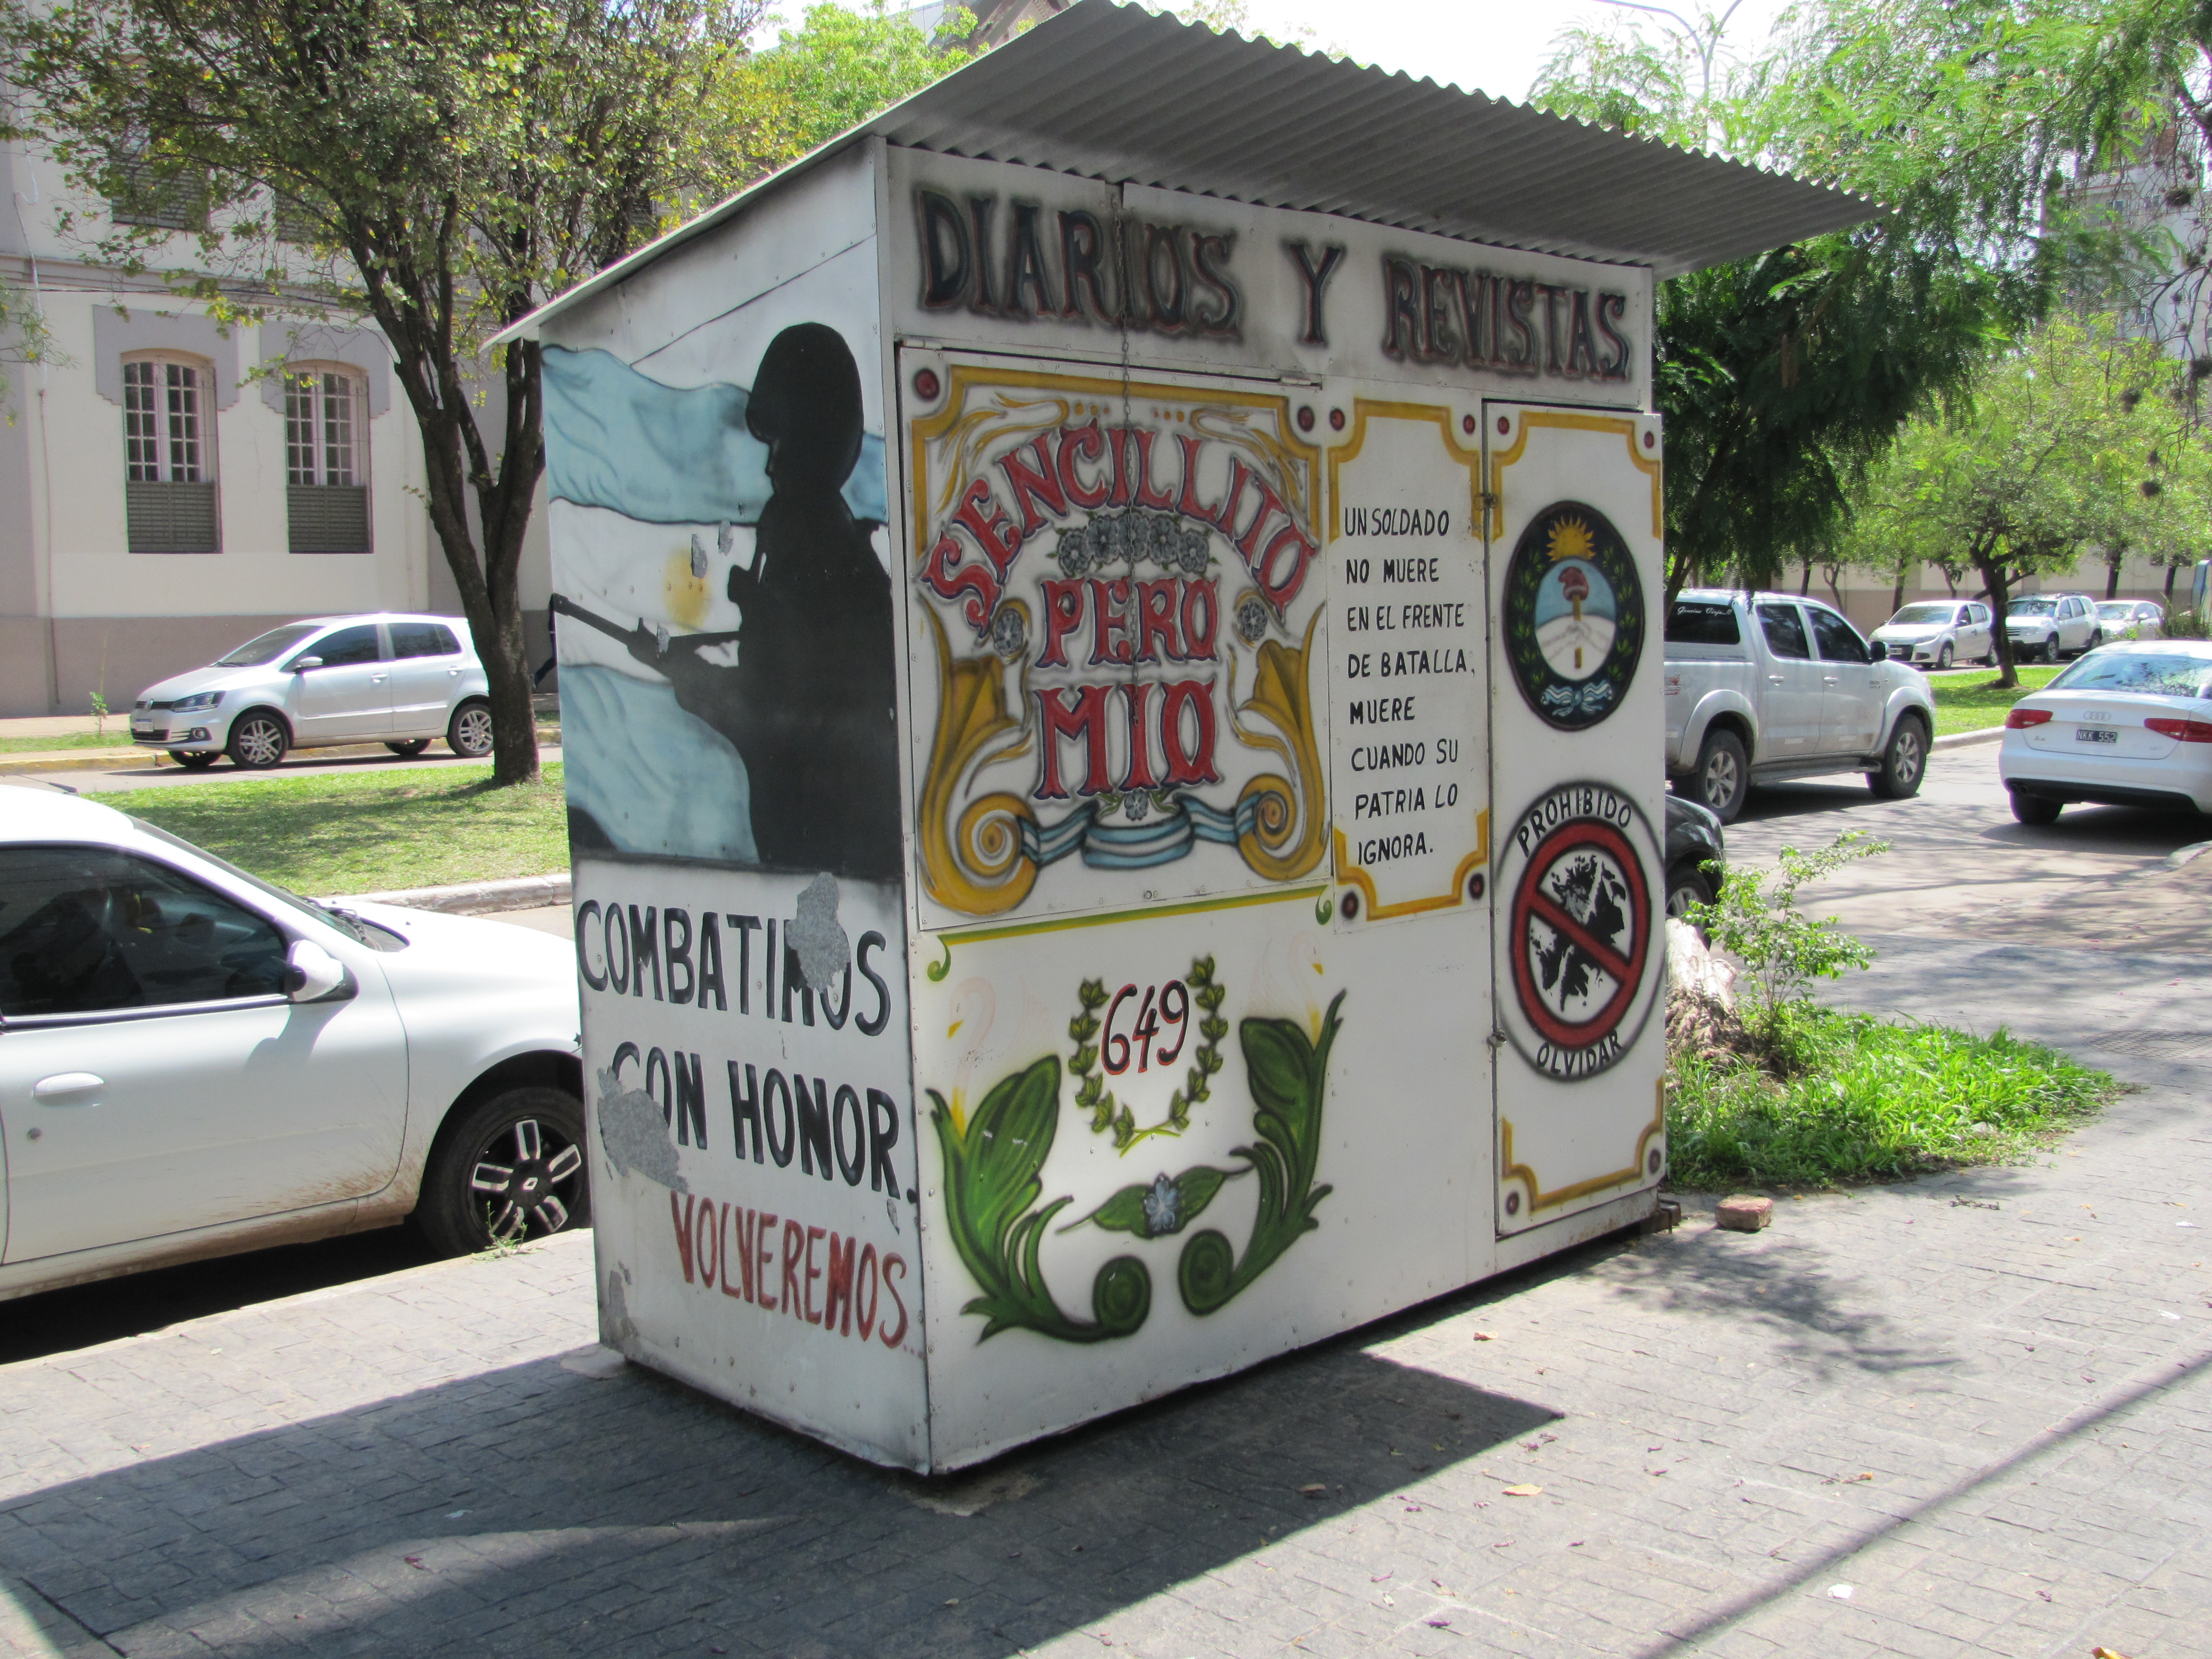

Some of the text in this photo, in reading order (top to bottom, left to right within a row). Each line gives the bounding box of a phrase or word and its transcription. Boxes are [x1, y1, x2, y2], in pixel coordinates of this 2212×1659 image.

[918, 189, 1628, 382] DIARIOS Y REVISTAS
[921, 417, 1320, 639] SENCILLITO
[1345, 507, 1449, 536] UN SOLDADO
[1346, 557, 1439, 585] NO MUERE
[1035, 575, 1218, 668] PERO
[1347, 603, 1464, 632] EN EL FRENTE
[1348, 649, 1475, 679] DE BATALLA,
[1350, 695, 1416, 724] MUERE
[1033, 679, 1219, 800] MIO
[1351, 738, 1458, 771] CUANDO SU
[2098, 732, 2116, 742] 552
[1355, 782, 1458, 820] PATRIA LO
[1516, 787, 1632, 857] PROHIBIDO
[1358, 832, 1433, 865] IGNORA.
[1101, 979, 1190, 1076] 649
[1536, 1029, 1623, 1076] OLVIDAR
